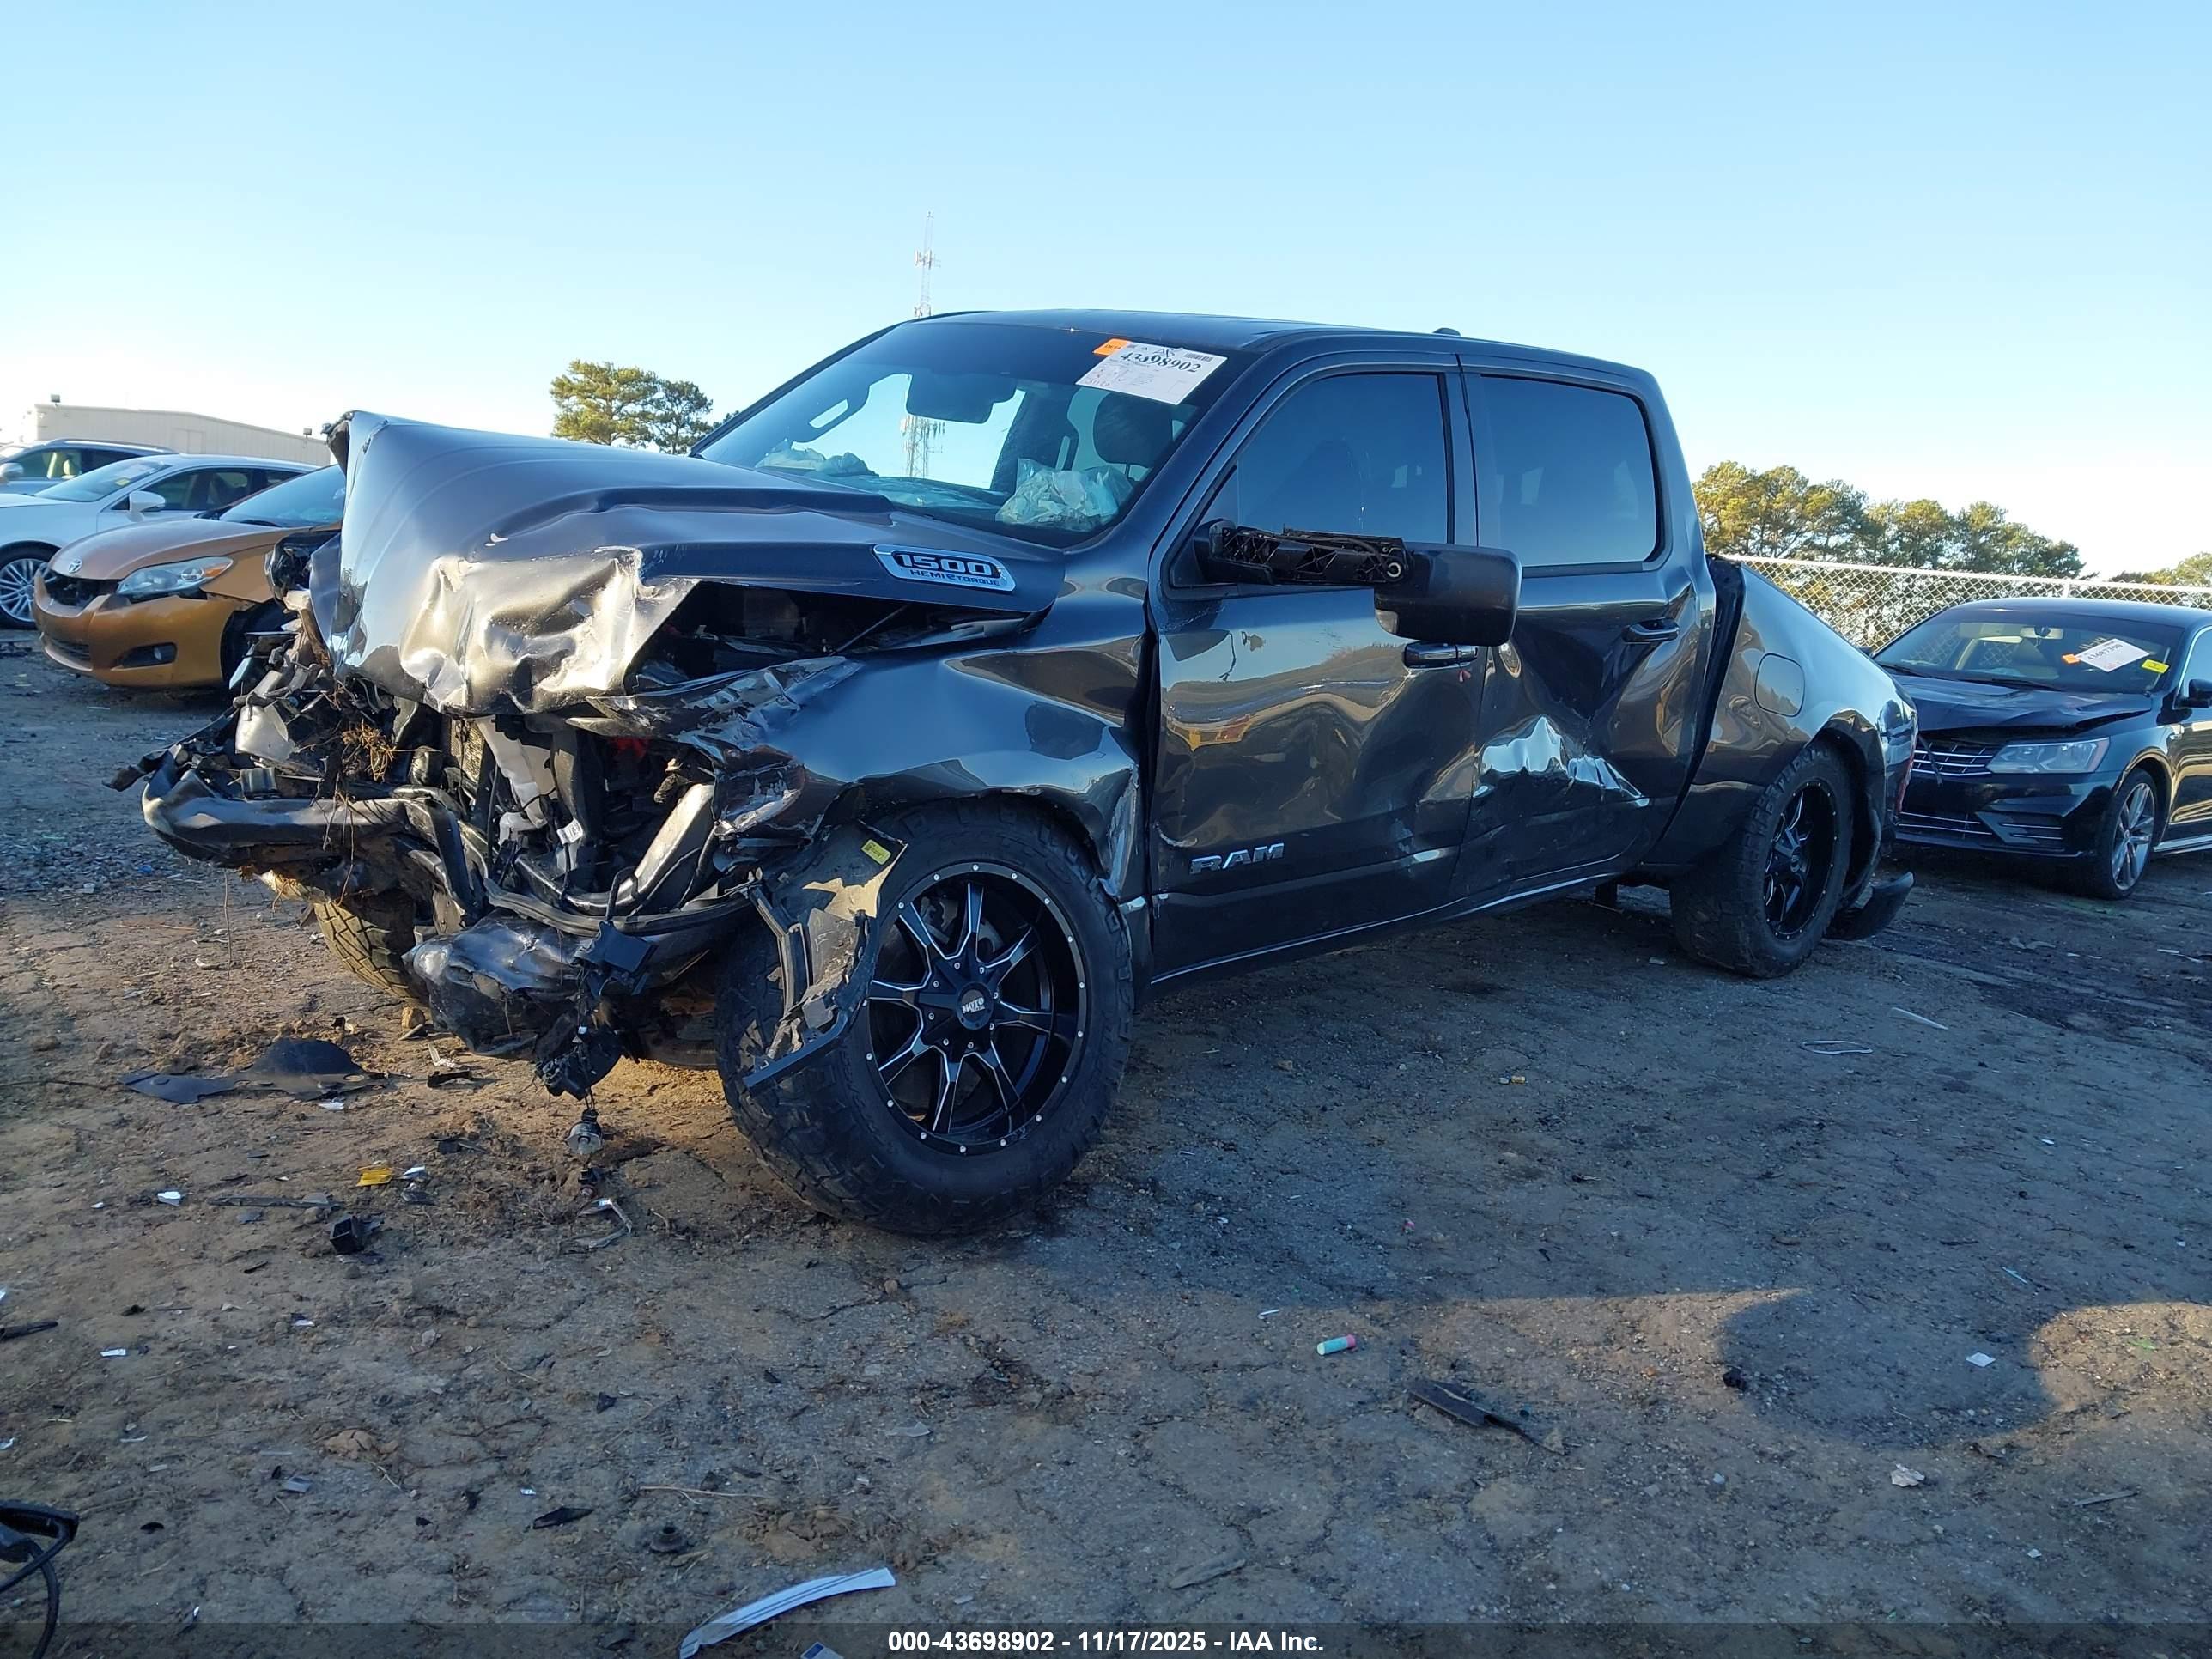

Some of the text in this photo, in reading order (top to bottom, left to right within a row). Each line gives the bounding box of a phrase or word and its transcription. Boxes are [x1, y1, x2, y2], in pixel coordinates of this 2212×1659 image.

[896, 554, 993, 576] 1500
[910, 569, 945, 580] HEMI
[1189, 842, 1285, 874] RAM
[962, 997, 984, 1014] MOTO
